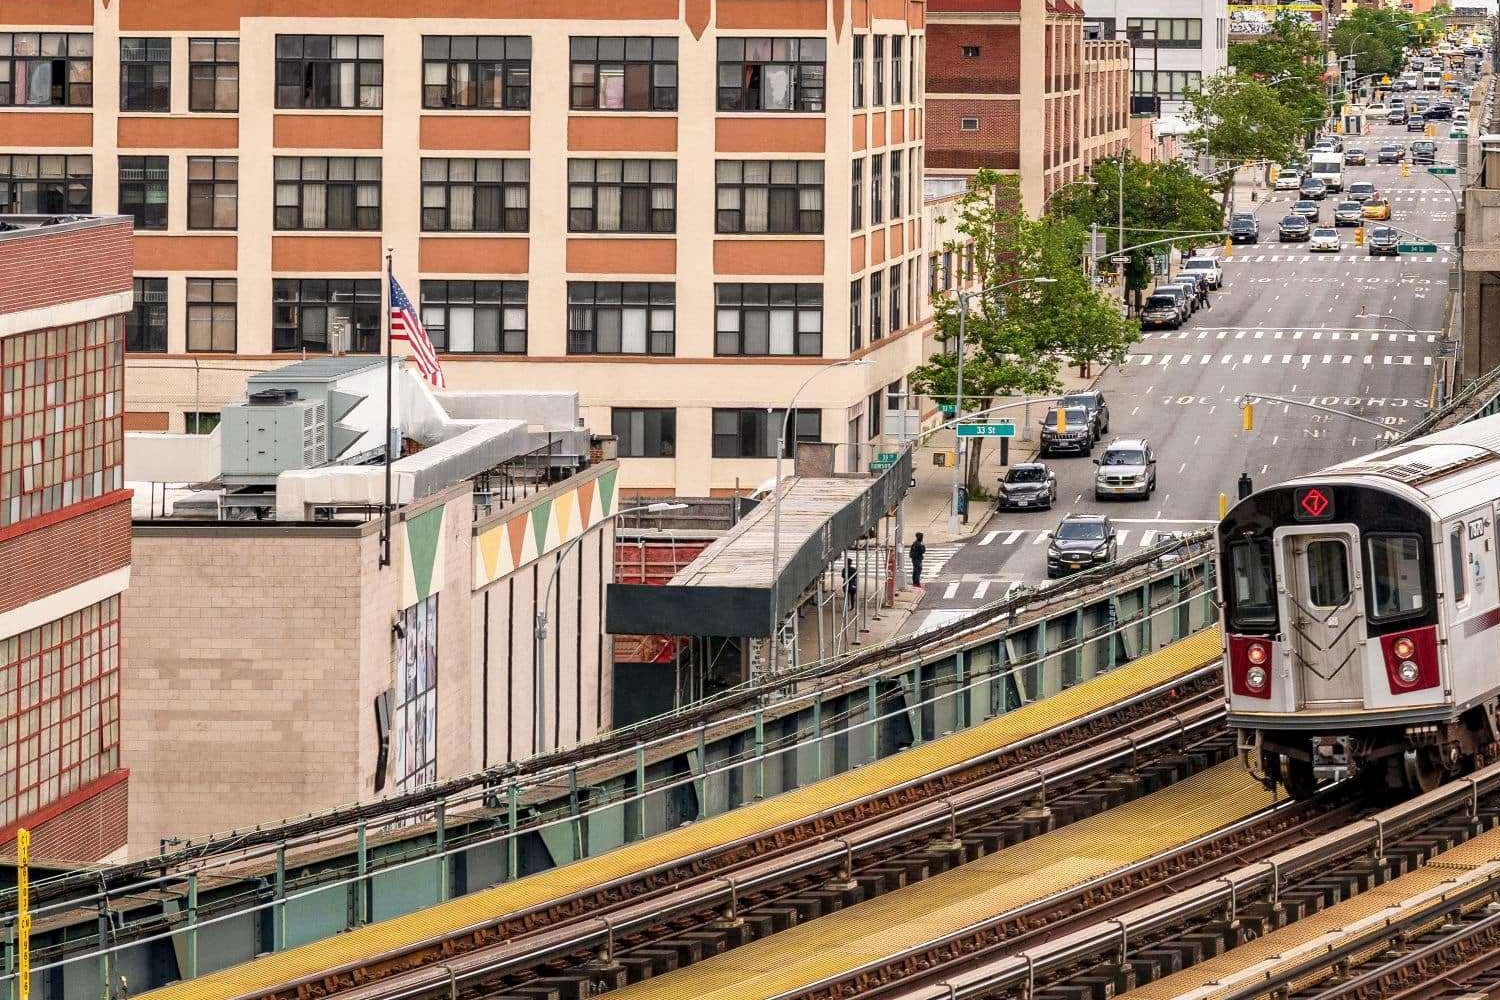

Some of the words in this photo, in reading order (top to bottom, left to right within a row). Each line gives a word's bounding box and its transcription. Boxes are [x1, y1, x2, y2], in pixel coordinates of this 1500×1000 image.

[976, 426, 986, 434] 33
[987, 426, 996, 434] St
[1310, 495, 1319, 511] 7
